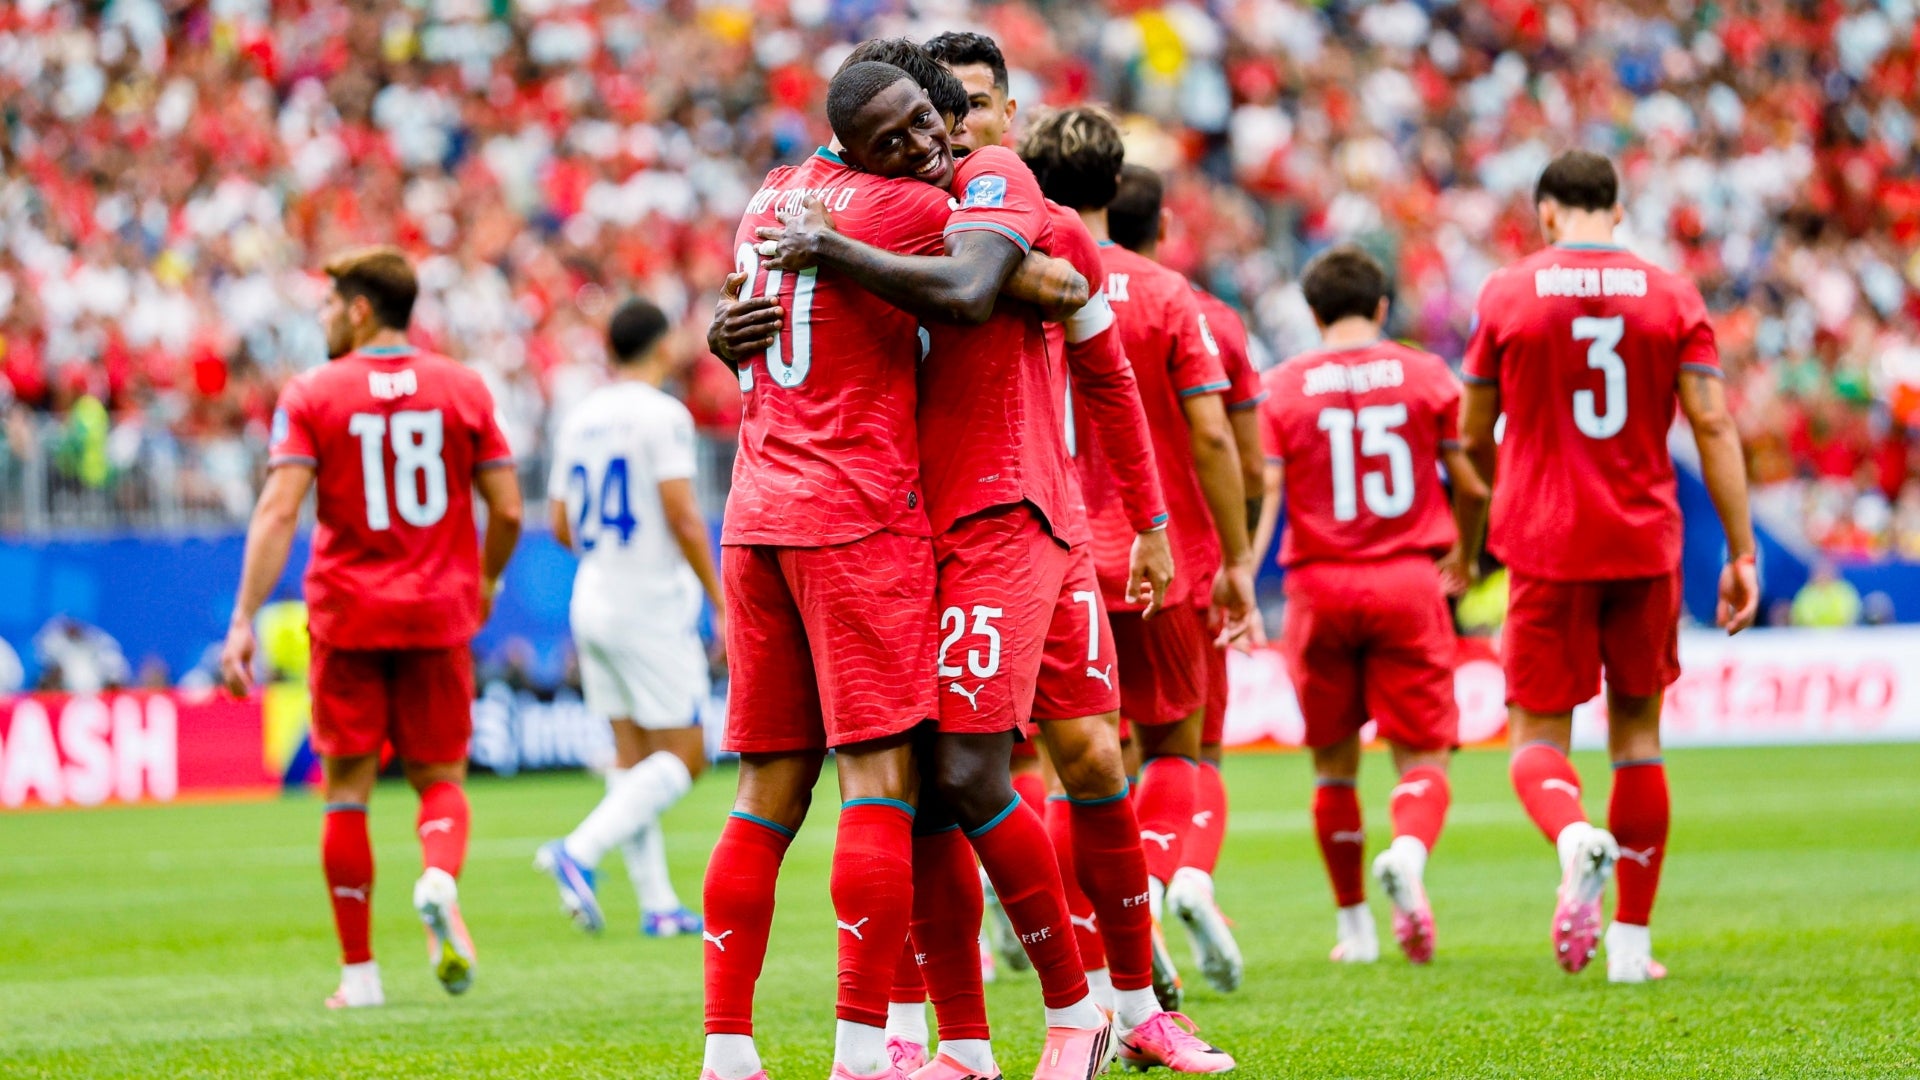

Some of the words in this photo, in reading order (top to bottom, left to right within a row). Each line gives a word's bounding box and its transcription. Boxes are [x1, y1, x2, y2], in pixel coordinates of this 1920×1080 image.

[737, 242, 817, 394] 20
[1602, 267, 1648, 298] DIAS
[1571, 315, 1628, 440] 3
[348, 407, 449, 532] 18
[571, 457, 637, 549] 24
[1317, 402, 1416, 522] 15
[937, 605, 1004, 679] 25
[1073, 590, 1100, 662] 7
[0, 693, 180, 808] ASH
